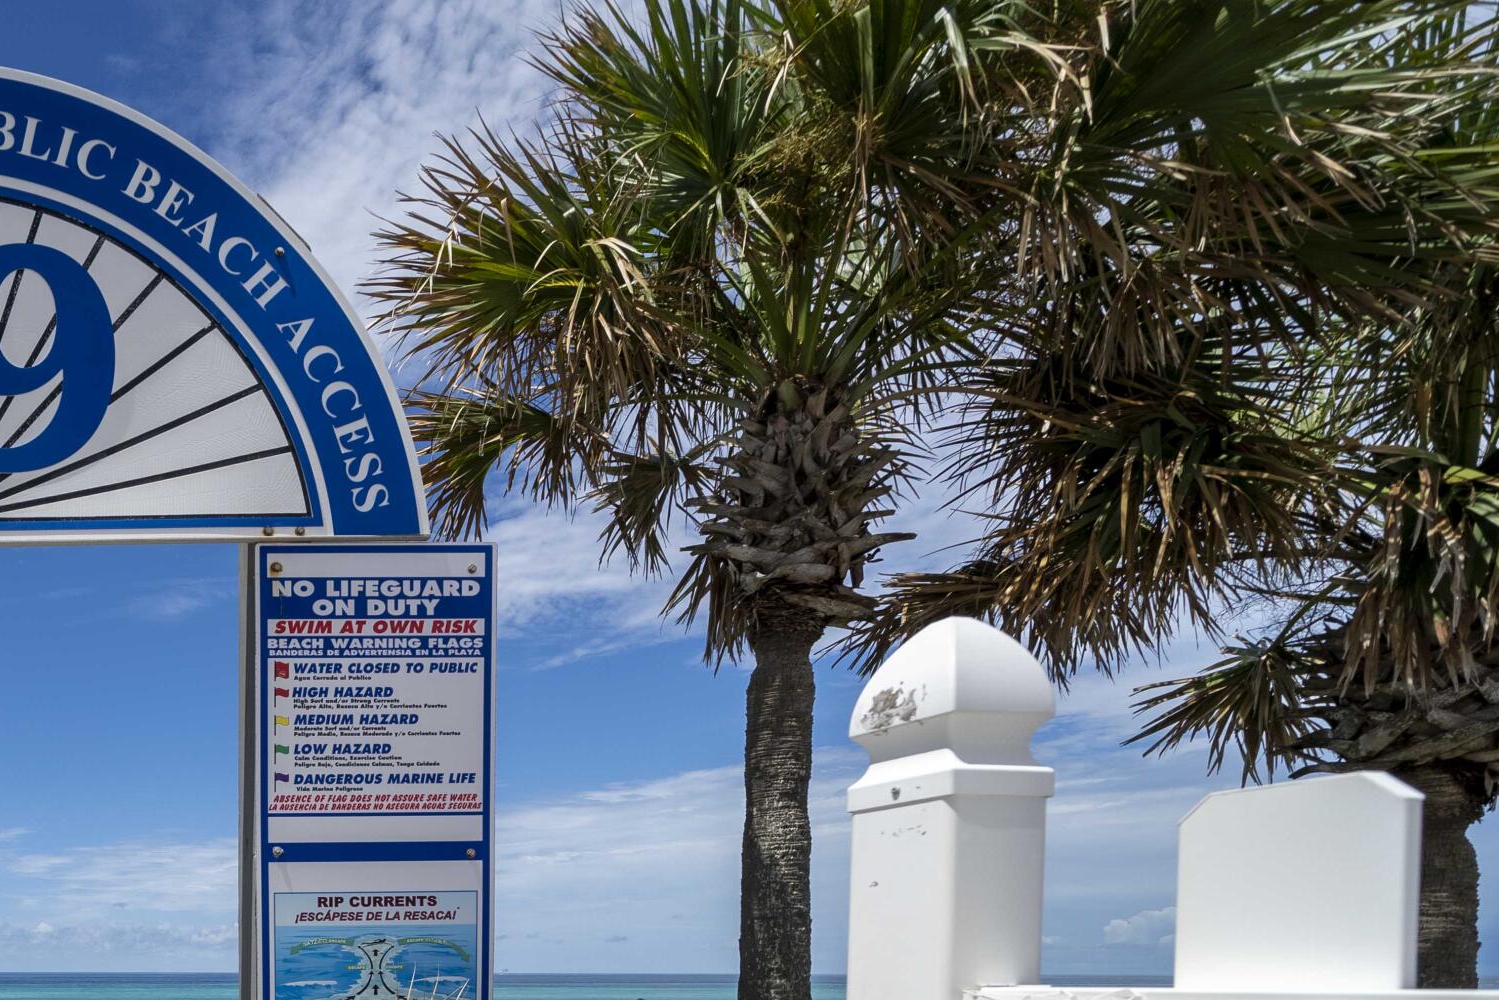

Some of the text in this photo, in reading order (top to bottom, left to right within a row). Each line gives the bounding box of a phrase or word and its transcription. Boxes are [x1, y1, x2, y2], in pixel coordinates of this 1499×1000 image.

[122, 158, 290, 311] BEACH
[275, 316, 390, 514] ACCESS
[272, 580, 480, 597] NO LIFEGUARD
[312, 599, 439, 616] ON DUTY
[275, 620, 477, 634] SWIM AT OWN RISK
[267, 638, 483, 649] BEACH WARNING FLAGS
[294, 662, 478, 674] WATER CLOSED TO PUBLIC
[292, 687, 393, 698] HIGH HAZARD
[294, 714, 419, 725] MEDIUM HAZARD
[294, 743, 391, 755] LOW HAZARD
[294, 773, 476, 785] DANGEROUS MARINE LIFE
[274, 795, 312, 803] ABSENCE
[349, 794, 372, 802] DOES
[374, 794, 391, 802] NOT
[392, 794, 425, 802] ASSURE
[426, 794, 447, 802] SAFE
[318, 803, 329, 811] DE
[422, 802, 446, 810] AGUAS
[317, 896, 437, 907] RIP CURRENTS
[295, 911, 363, 923] ¡ESCÁPESE
[366, 911, 383, 921] DE
[385, 911, 400, 921] LA
